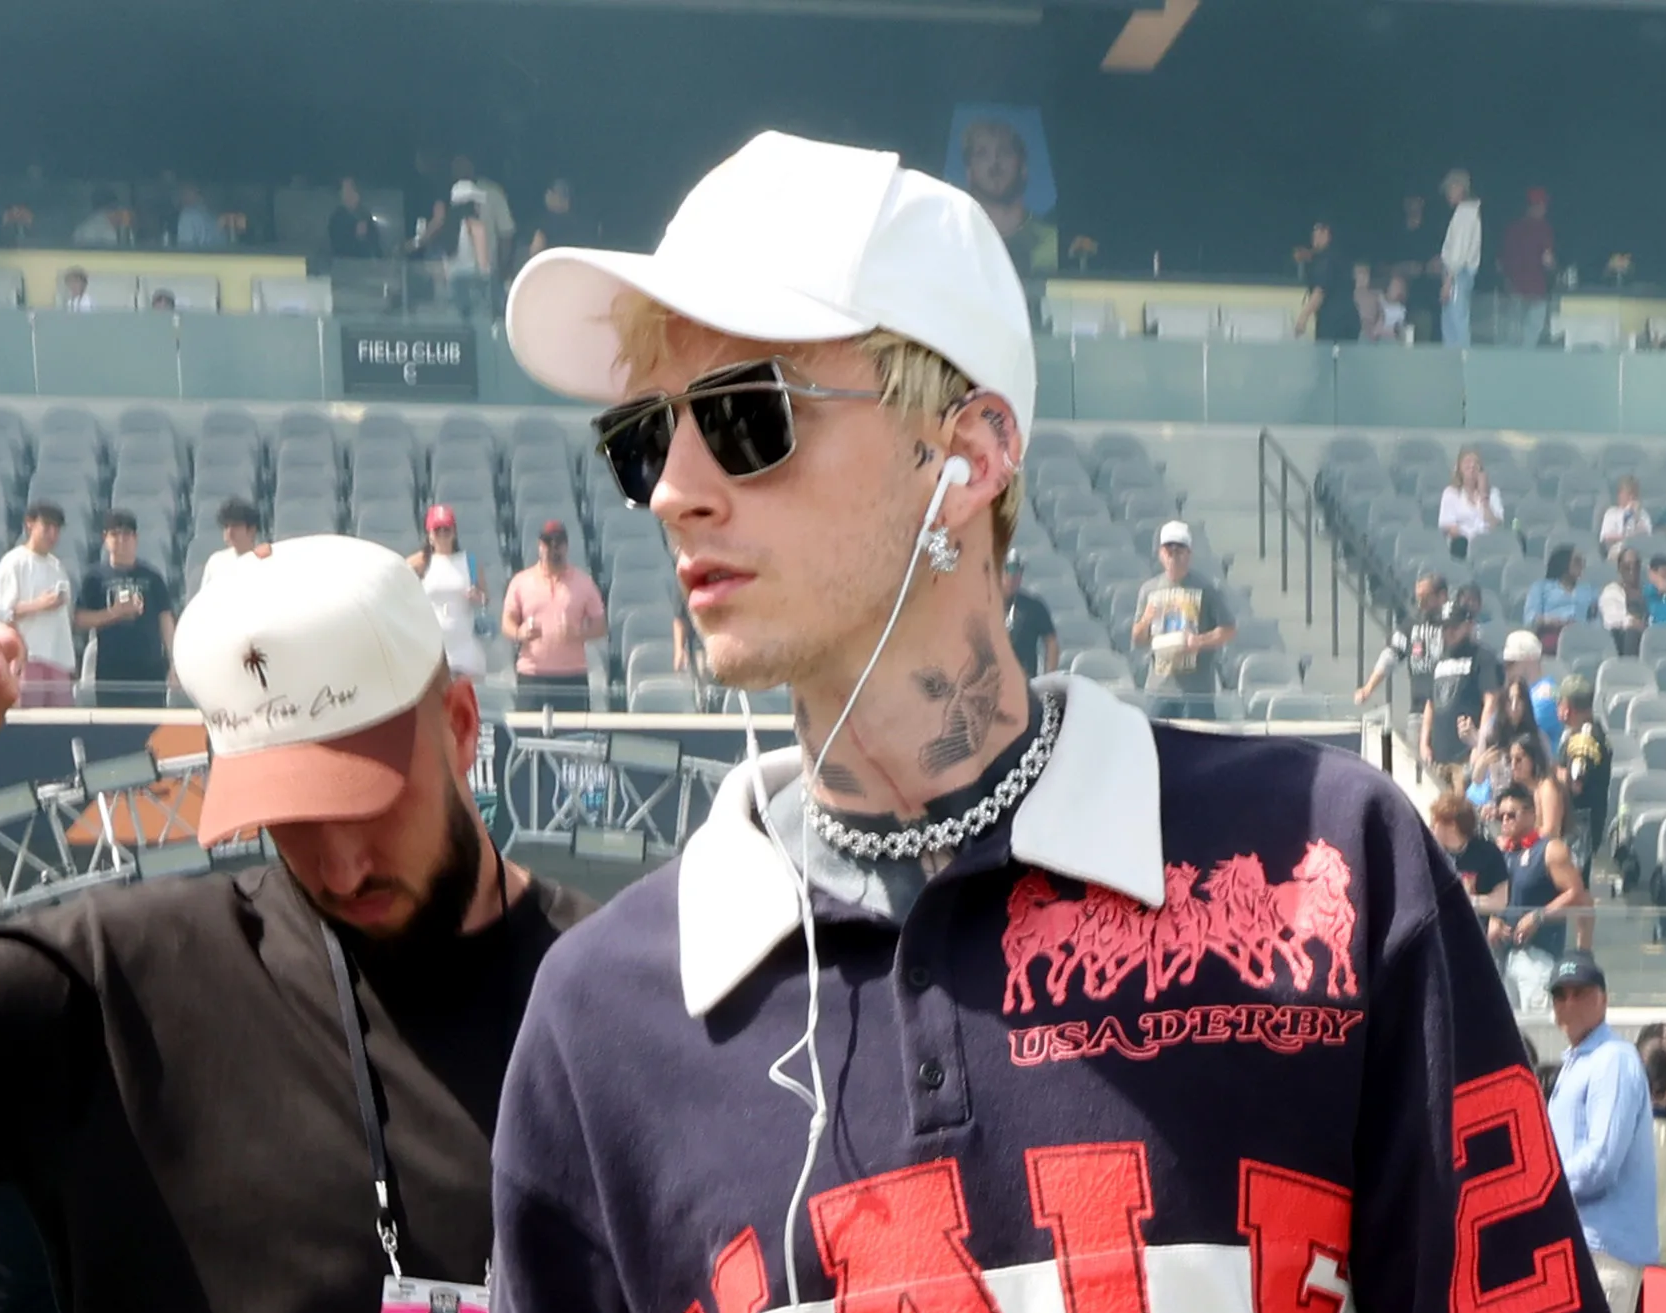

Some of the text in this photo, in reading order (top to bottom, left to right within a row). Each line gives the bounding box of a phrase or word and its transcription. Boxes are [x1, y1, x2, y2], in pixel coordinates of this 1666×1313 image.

[358, 340, 461, 365] FIELD CLUB
[1008, 1003, 1364, 1067] USA DERBY
